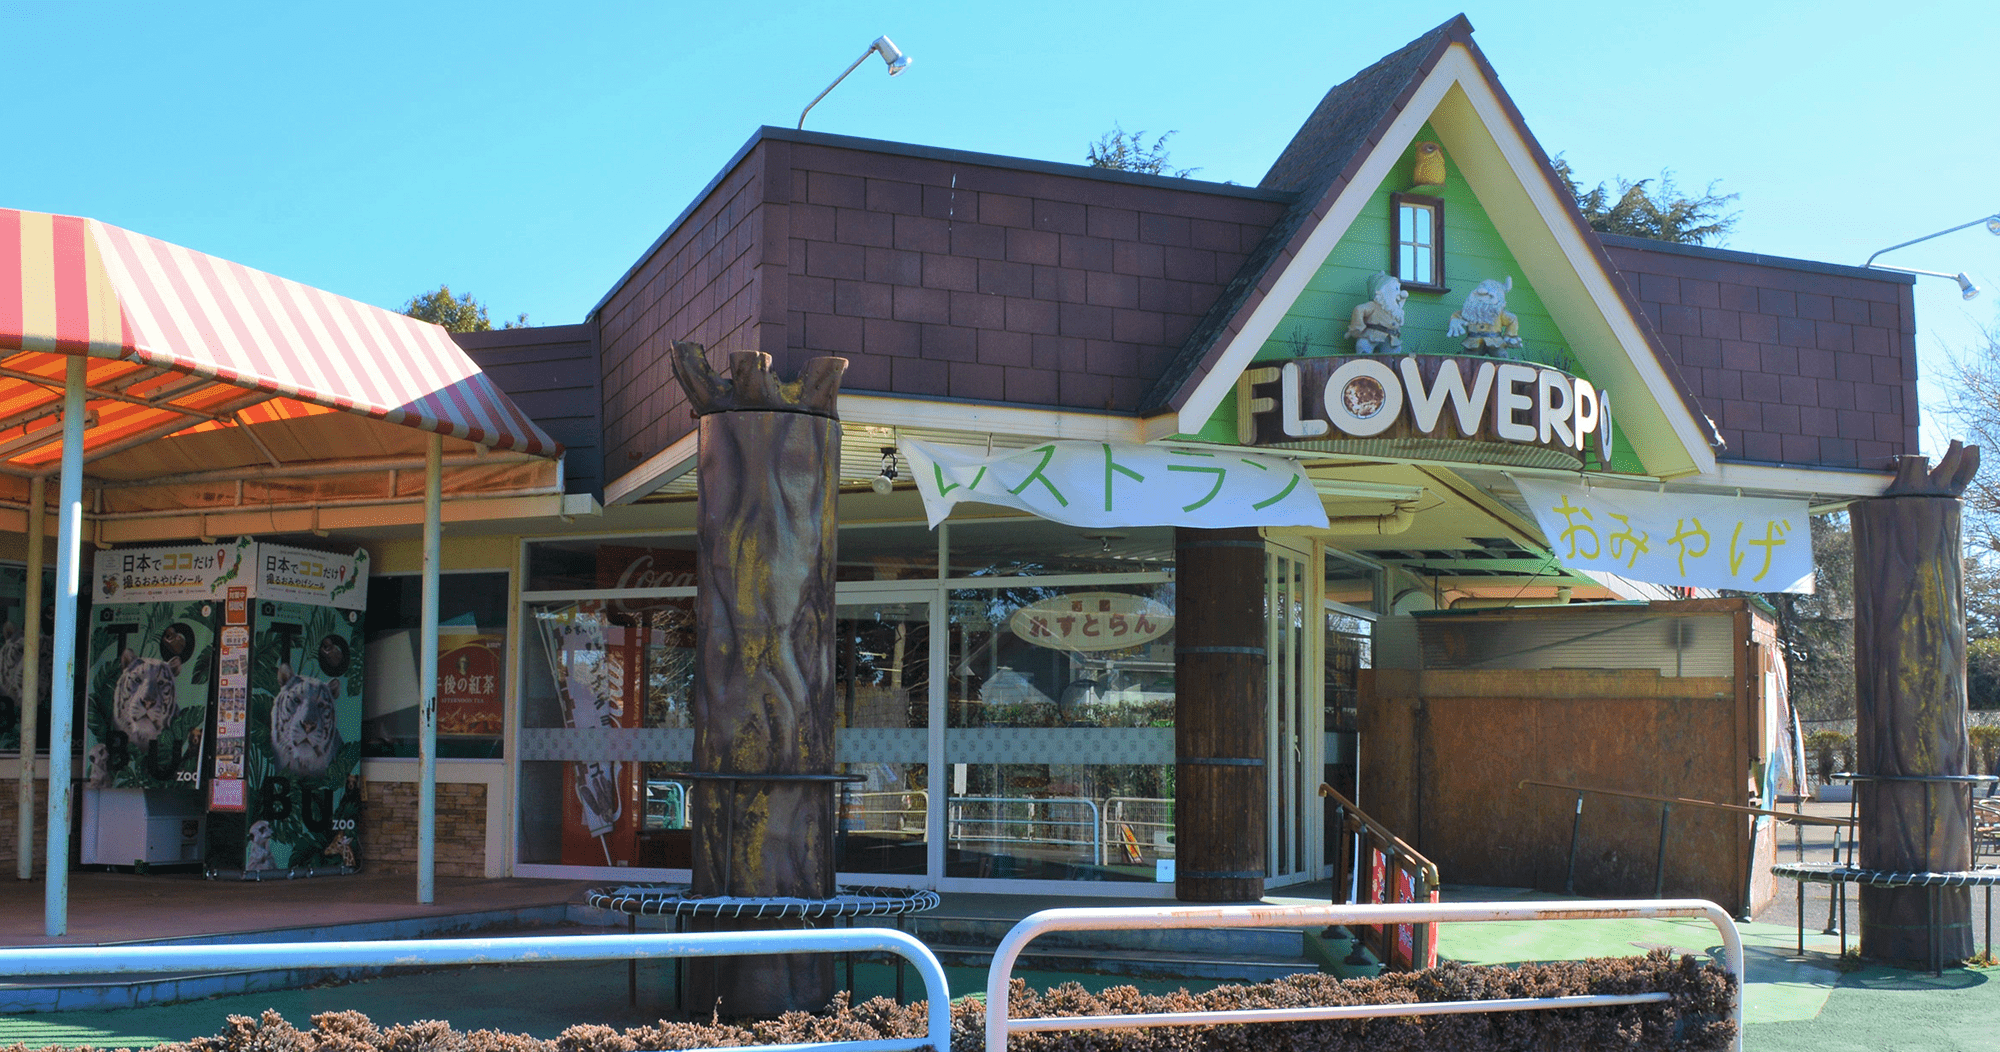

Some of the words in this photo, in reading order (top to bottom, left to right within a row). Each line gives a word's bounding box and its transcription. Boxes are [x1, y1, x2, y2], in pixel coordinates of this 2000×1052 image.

[933, 442, 1301, 513] レストラン
[1552, 494, 1792, 583] おみやげ
[123, 553, 214, 573] 日本でココだけ
[266, 555, 338, 580] 日本でココだけ
[123, 574, 203, 589] 撮るおみやげシール
[266, 573, 326, 589] 撮るおみやげシール
[1029, 613, 1156, 638] れすとらん
